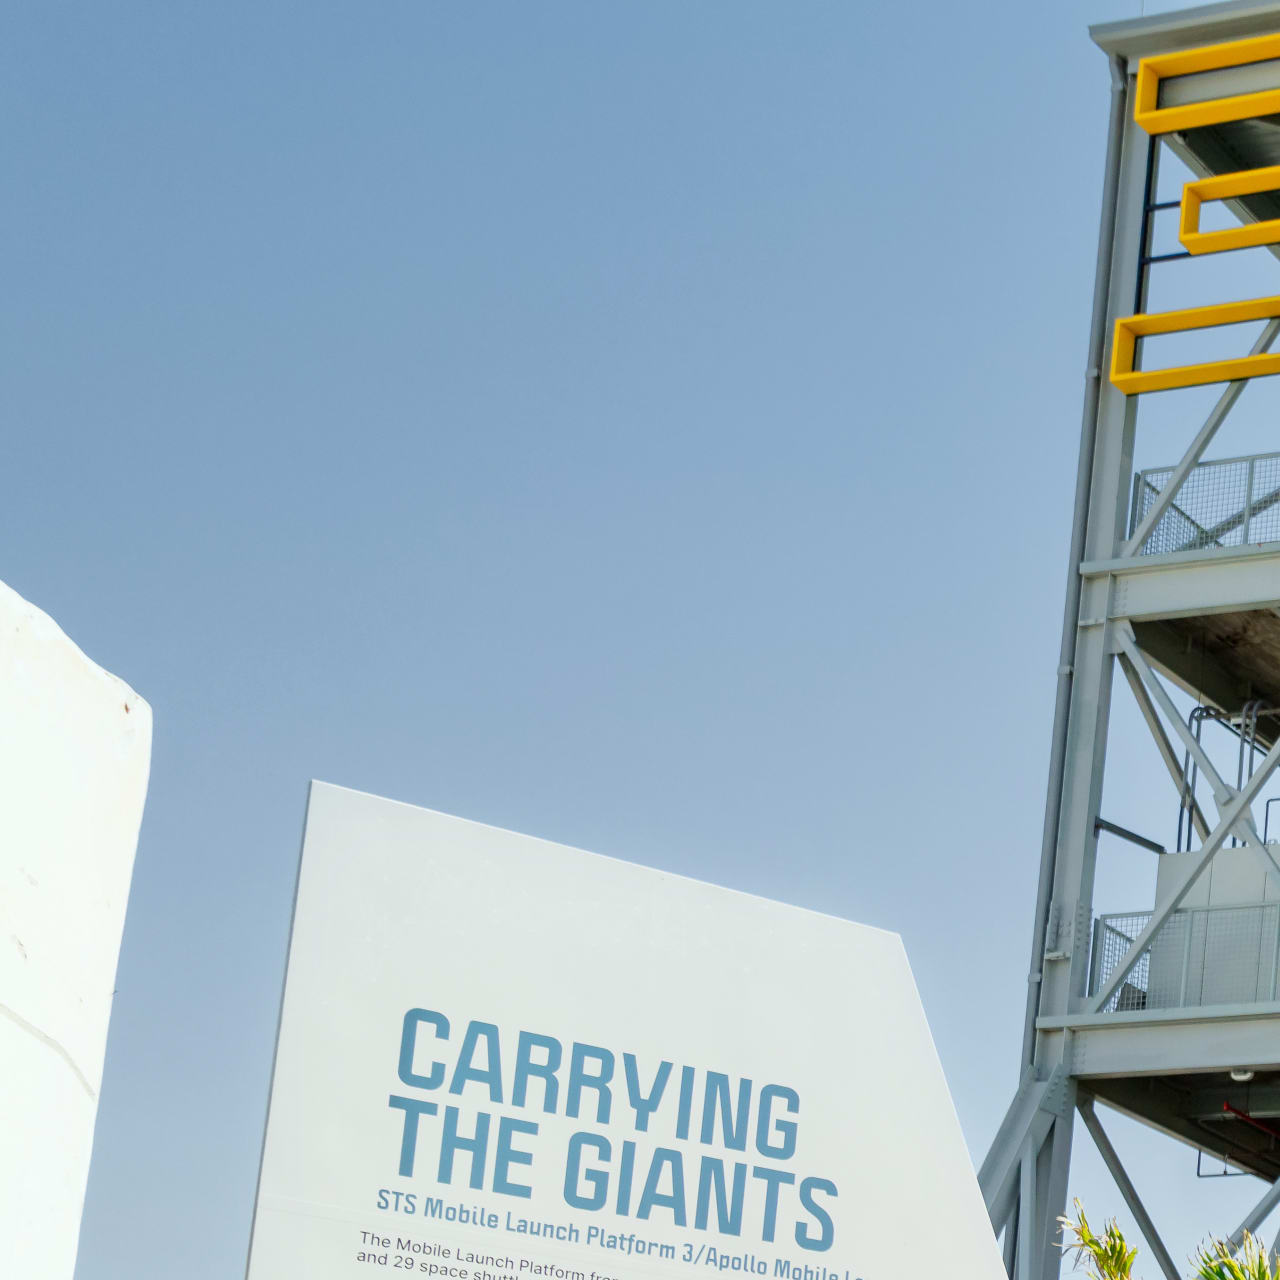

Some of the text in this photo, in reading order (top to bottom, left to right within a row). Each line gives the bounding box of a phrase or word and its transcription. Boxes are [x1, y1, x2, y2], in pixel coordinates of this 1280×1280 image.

[398, 1007, 800, 1160] CARRYING
[388, 1094, 839, 1252] THE GIANTS
[356, 1251, 388, 1266] and
[393, 1255, 415, 1270] 29
[419, 1262, 469, 1280] space
[360, 1230, 392, 1249] The
[396, 1237, 451, 1259] Mobile
[456, 1247, 514, 1270] Launch
[376, 1188, 418, 1215] STS
[423, 1196, 499, 1229] Mobile
[505, 1211, 580, 1244] Launch
[586, 1225, 676, 1260] Platform
[682, 1243, 768, 1276] 3/Apollo
